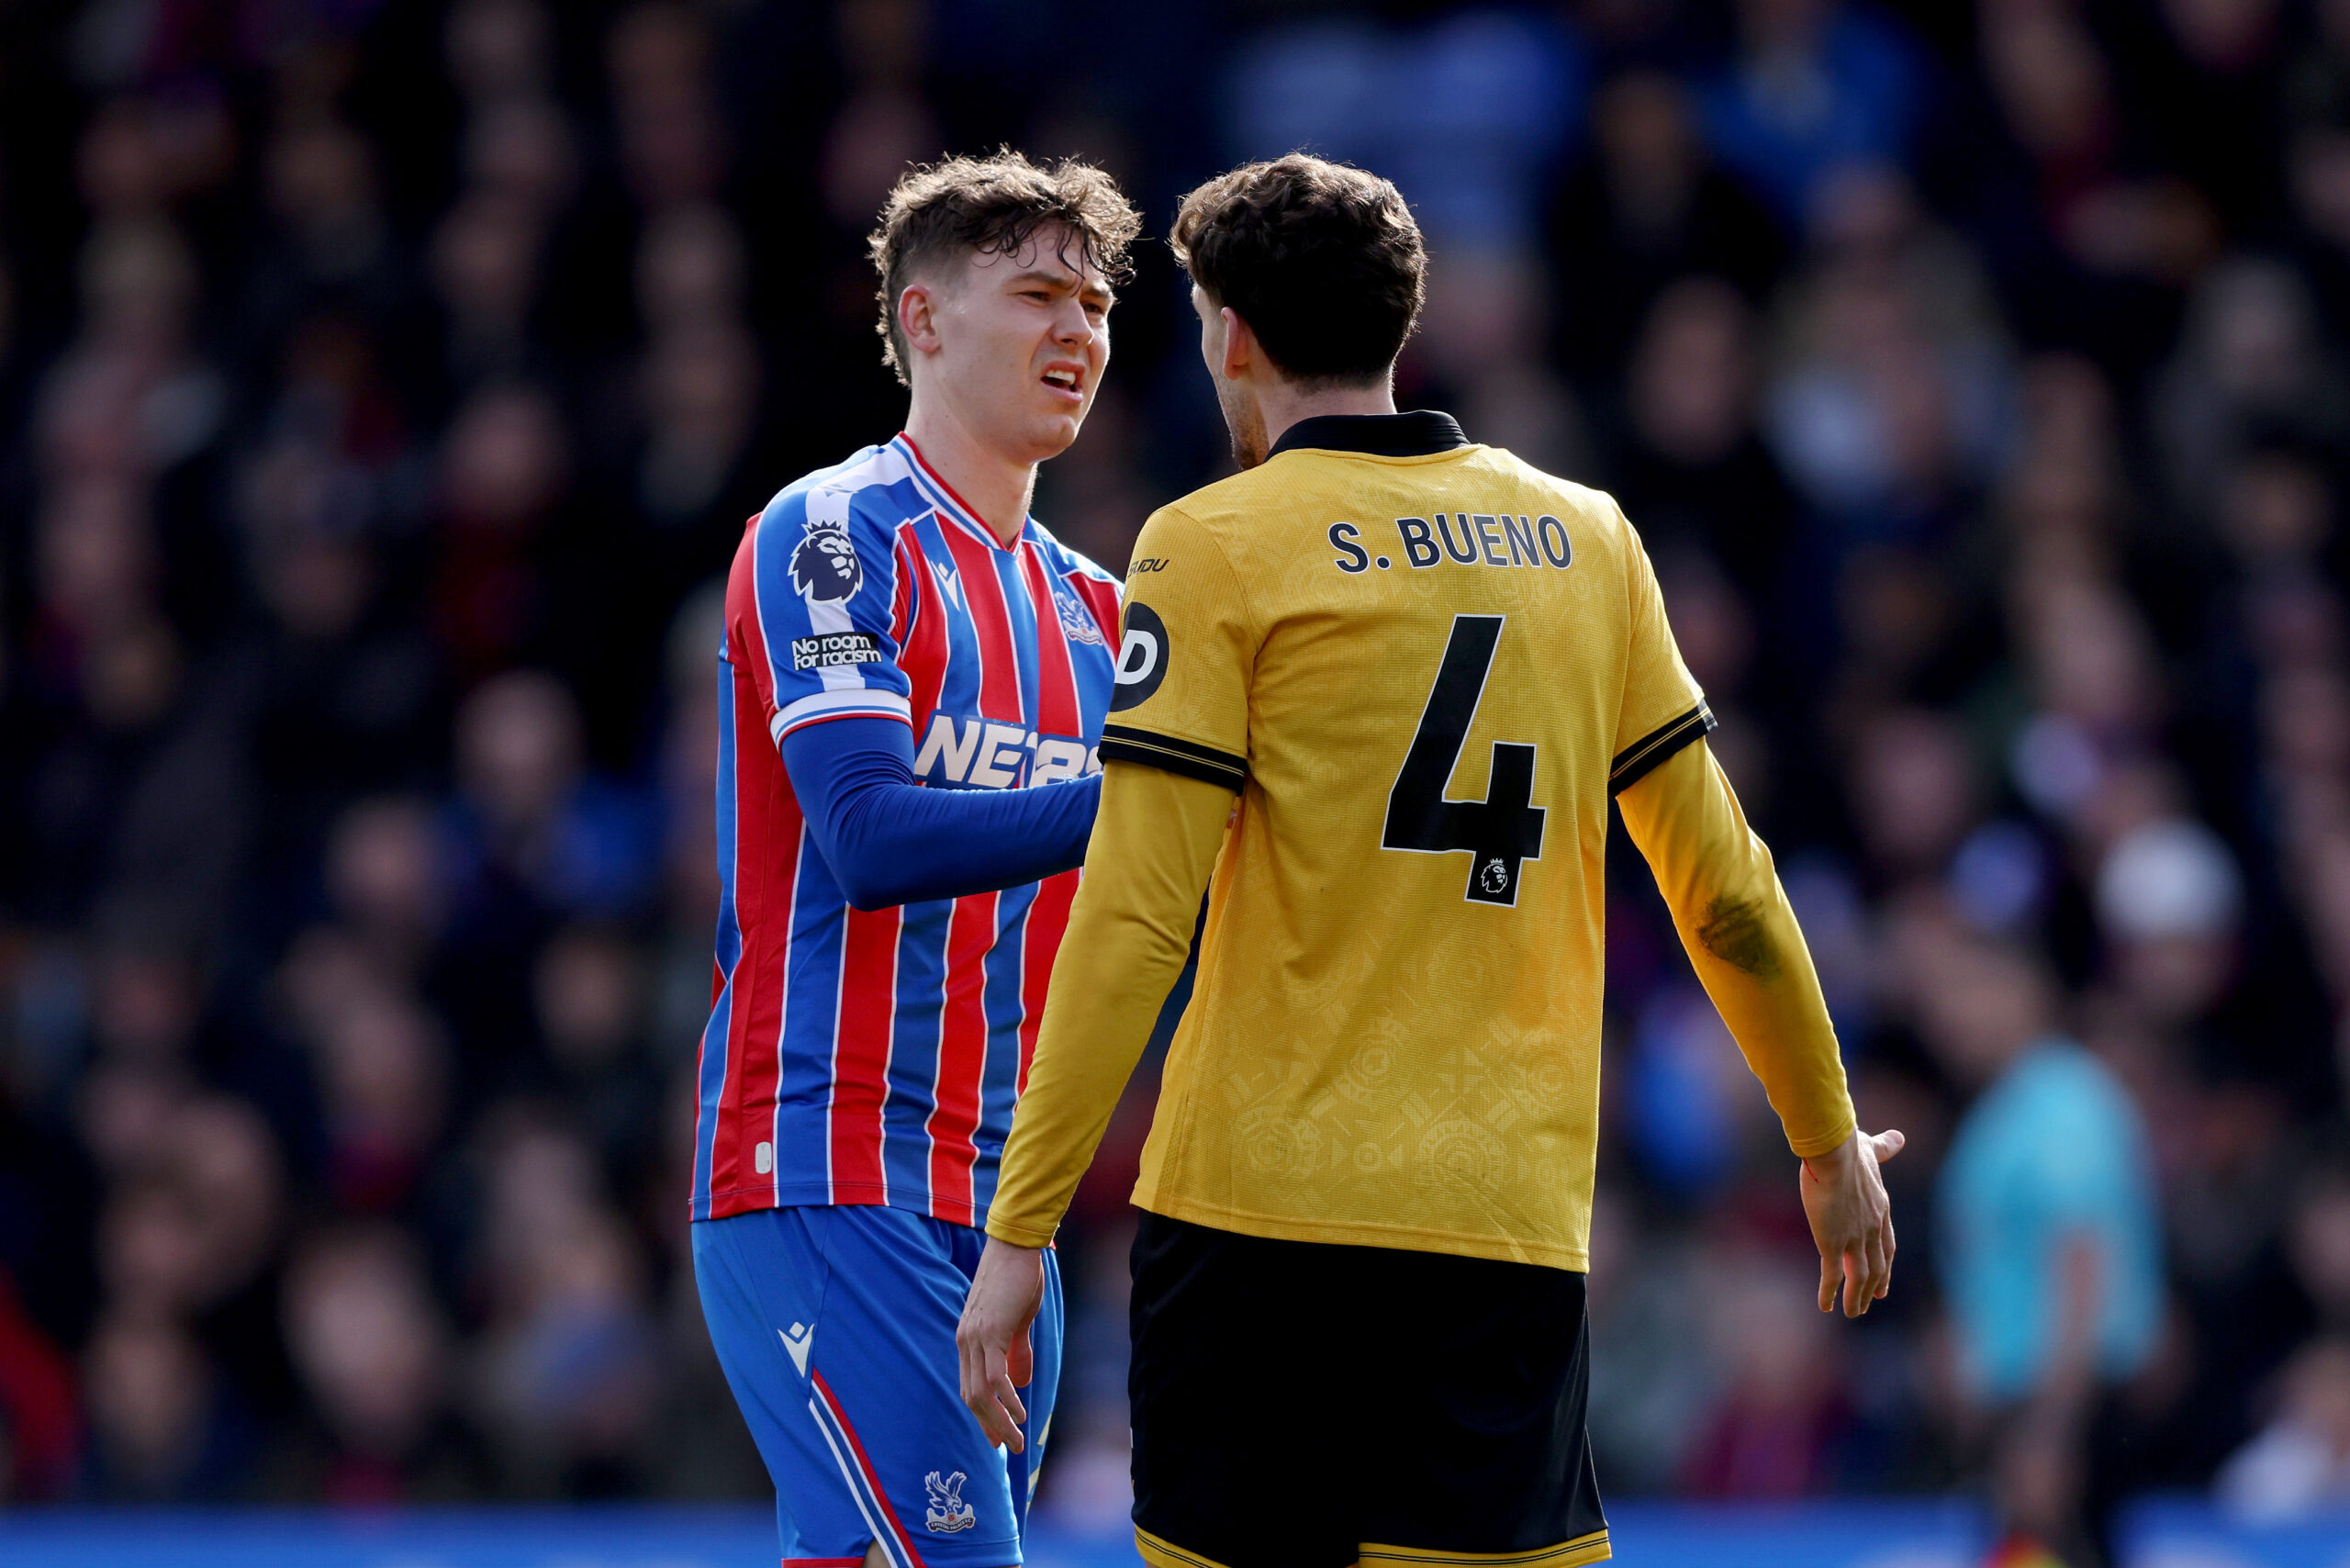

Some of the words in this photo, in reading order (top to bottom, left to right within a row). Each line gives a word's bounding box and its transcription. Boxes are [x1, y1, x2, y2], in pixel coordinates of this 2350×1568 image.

[1327, 521, 1392, 574] S.
[1394, 512, 1572, 570] BUENO
[791, 638, 819, 657] No
[822, 635, 871, 652] room
[794, 653, 820, 671] for
[822, 649, 882, 666] racism
[1380, 613, 1548, 908] 4
